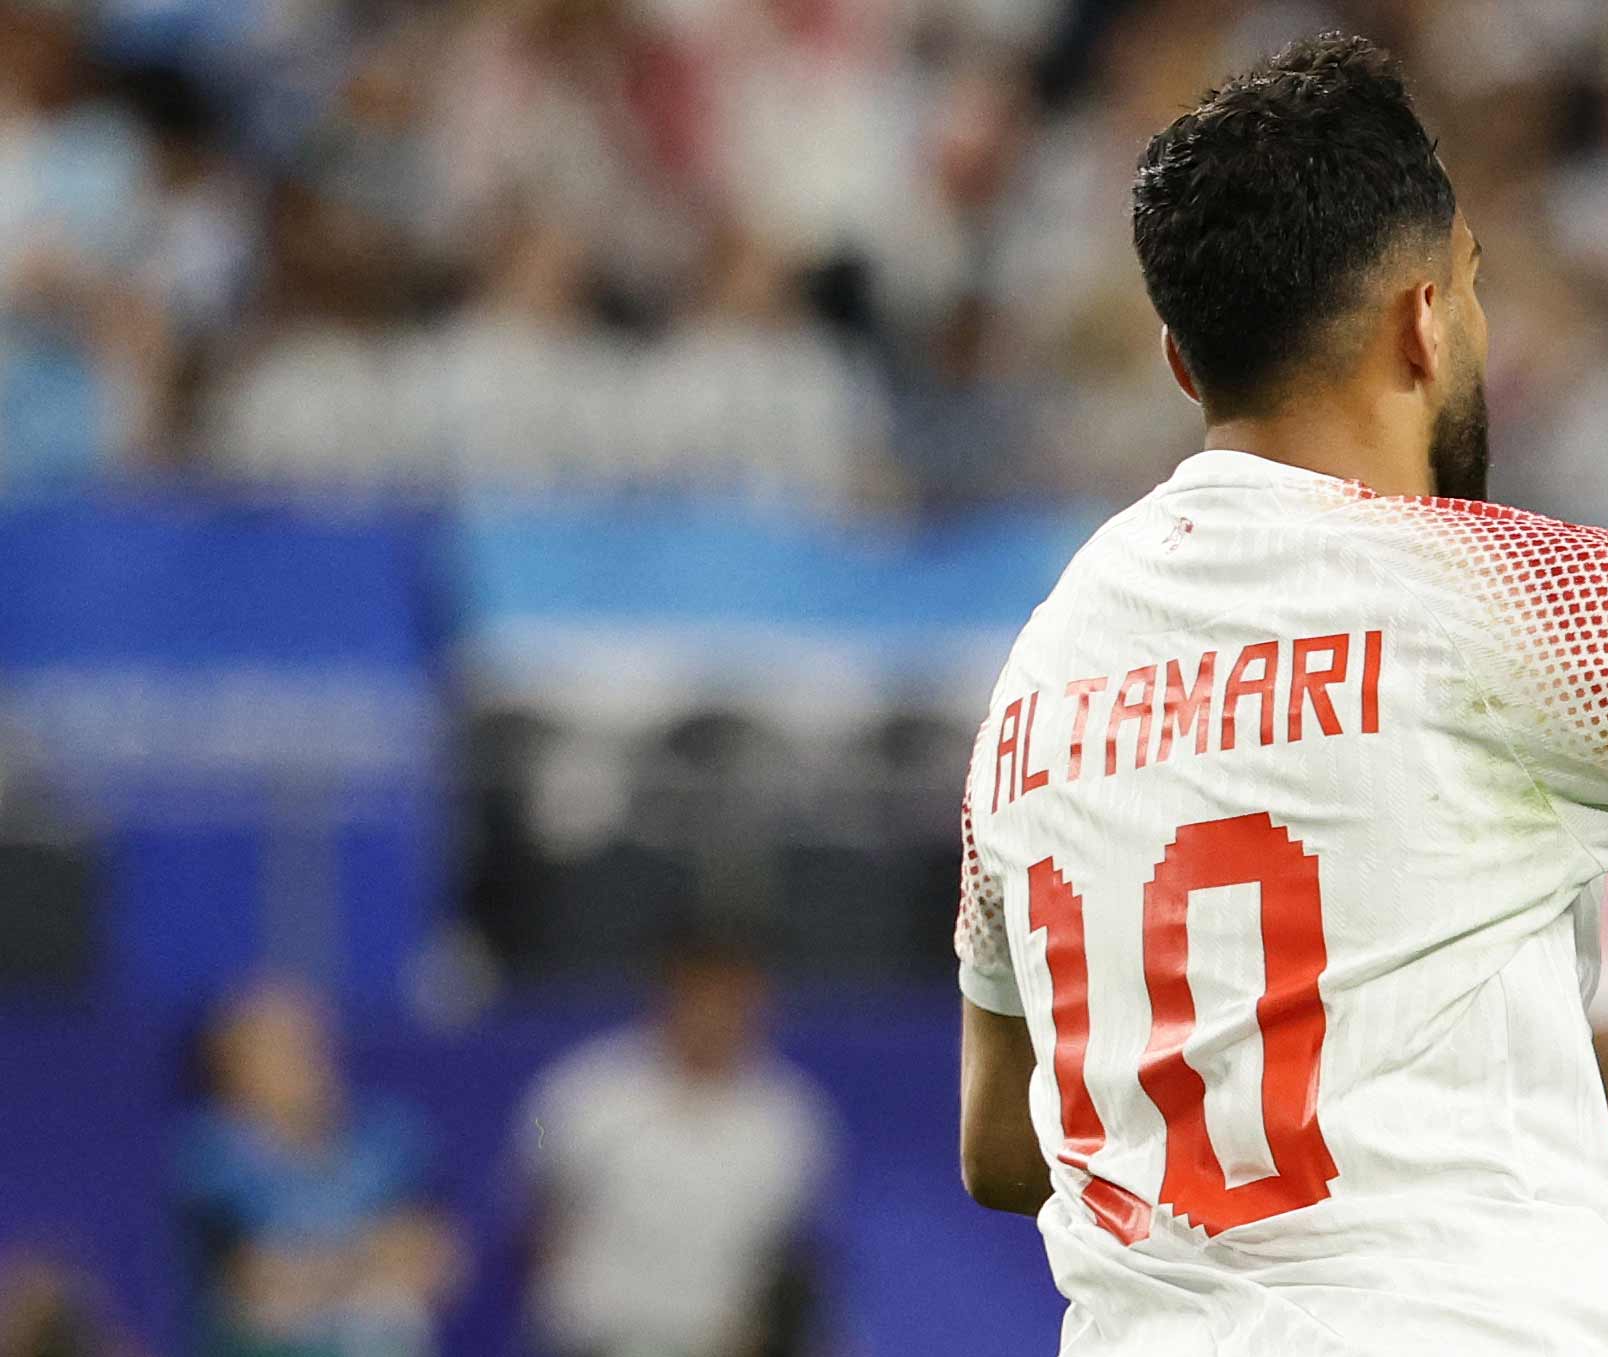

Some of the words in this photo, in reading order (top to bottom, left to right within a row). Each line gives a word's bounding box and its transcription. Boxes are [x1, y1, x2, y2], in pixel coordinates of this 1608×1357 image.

[991, 691, 1050, 815] AL
[1064, 630, 1384, 783] TAMARI
[1027, 810, 1342, 1248] 10
